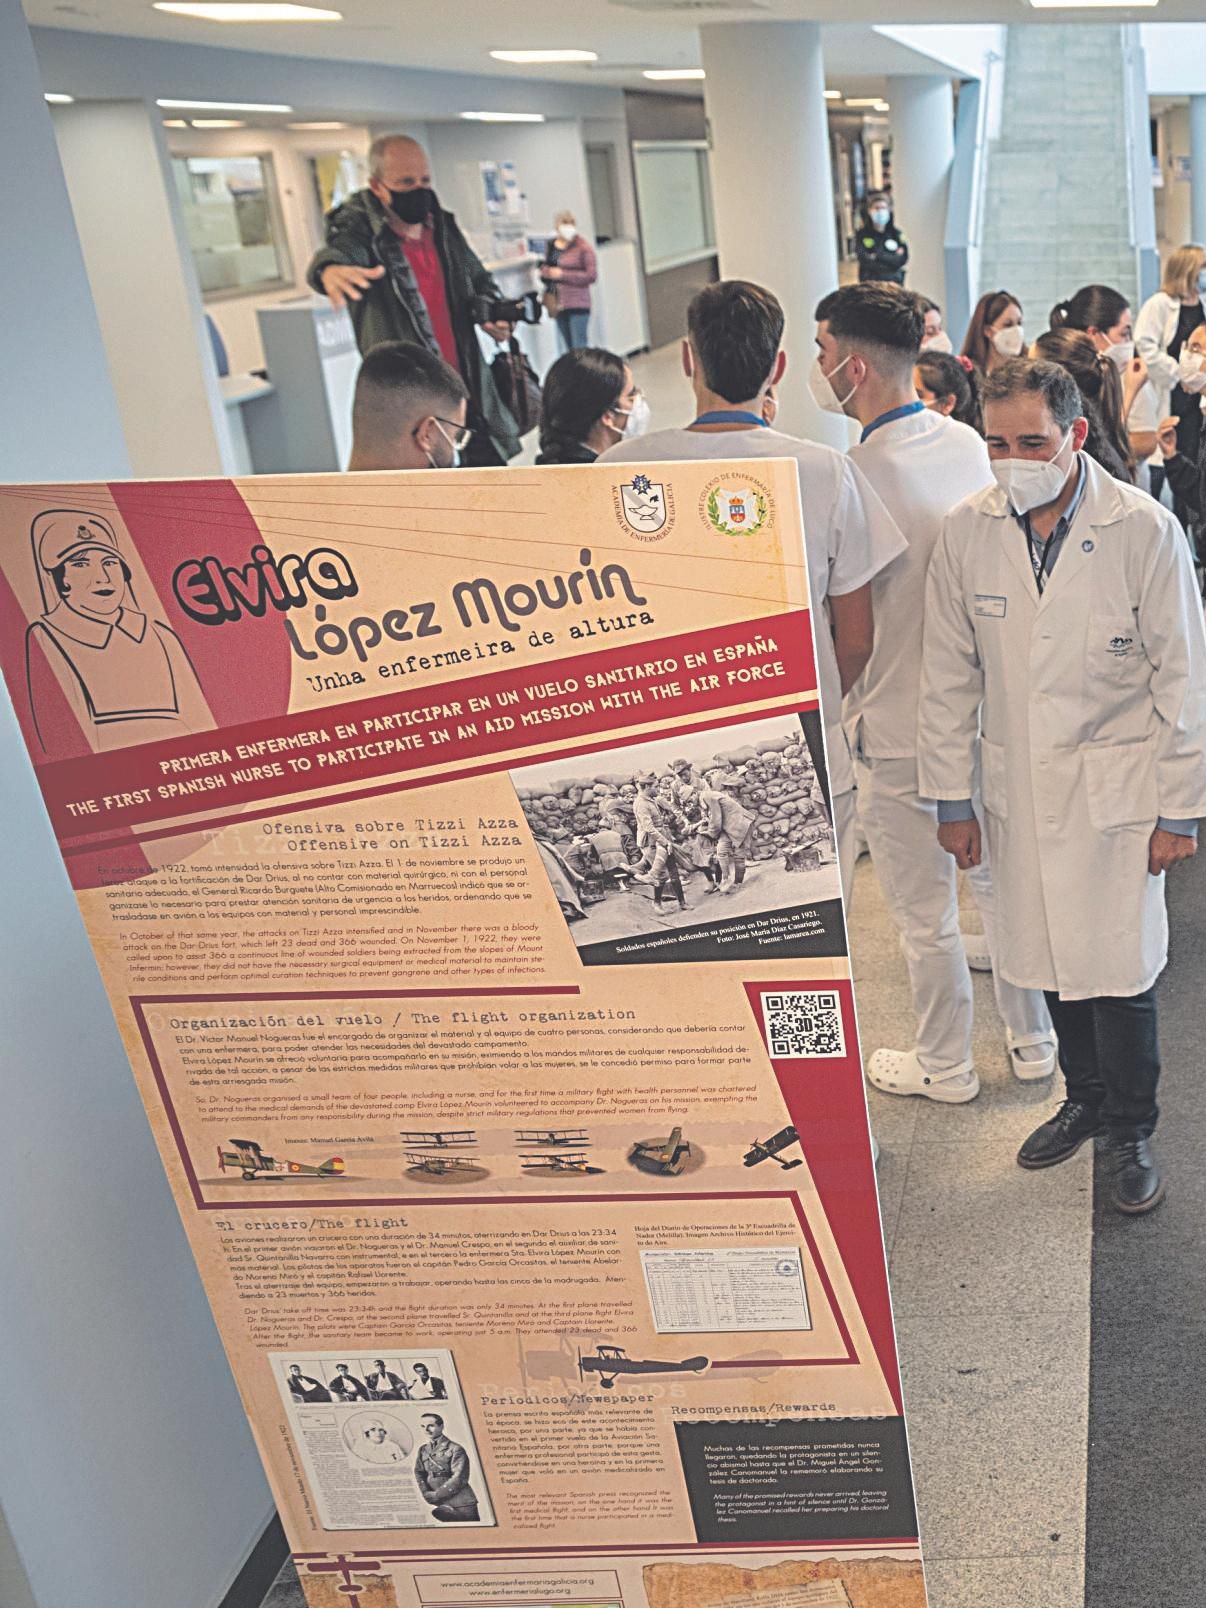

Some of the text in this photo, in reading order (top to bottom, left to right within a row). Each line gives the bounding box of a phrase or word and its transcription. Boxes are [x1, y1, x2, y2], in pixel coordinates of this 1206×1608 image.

[721, 473, 731, 481] DE
[611, 485, 624, 528] ACADEMIA
[621, 524, 631, 536] DE
[666, 483, 676, 516] GALICIA
[172, 543, 359, 626] Elvira
[284, 547, 647, 662] López Mourín
[306, 608, 655, 693] Unha enfermeira de altura
[159, 635, 779, 775] PRIMERA ENFERMERA EN PARTICIPAR EN UN VUELO SANITARIO EN ESPAÑA
[66, 660, 786, 818] THE FIRST SPANISH NURSE TO PARTICIPATE IN AN AID MISSION WITH THE AIR FORCE
[263, 817, 519, 835] Ofensiva sobre Tizzi Azza
[288, 834, 522, 851] Offensive on Tizzi Azza
[616, 942, 646, 953] Soldados
[646, 937, 678, 949] españoles
[678, 931, 710, 942] defienden
[719, 924, 746, 936] posición
[756, 918, 770, 927] Dar
[801, 910, 820, 919] 1921.
[717, 935, 735, 944] Foto:
[735, 932, 750, 941] José
[751, 927, 771, 938] María
[758, 926, 825, 945] Fuente: lamarea.com
[170, 1008, 636, 1032] Organización del vuelo / The flight organization
[794, 1017, 813, 1032] 3D
[244, 1217, 344, 1233] crucero/The
[355, 1217, 409, 1229] flight
[671, 1402, 836, 1416] Recompensas/Rewards
[704, 1445, 733, 1453] Muchas
[748, 1443, 760, 1451] las
[762, 1443, 811, 1452] recompensas
[813, 1442, 855, 1451] prometidas
